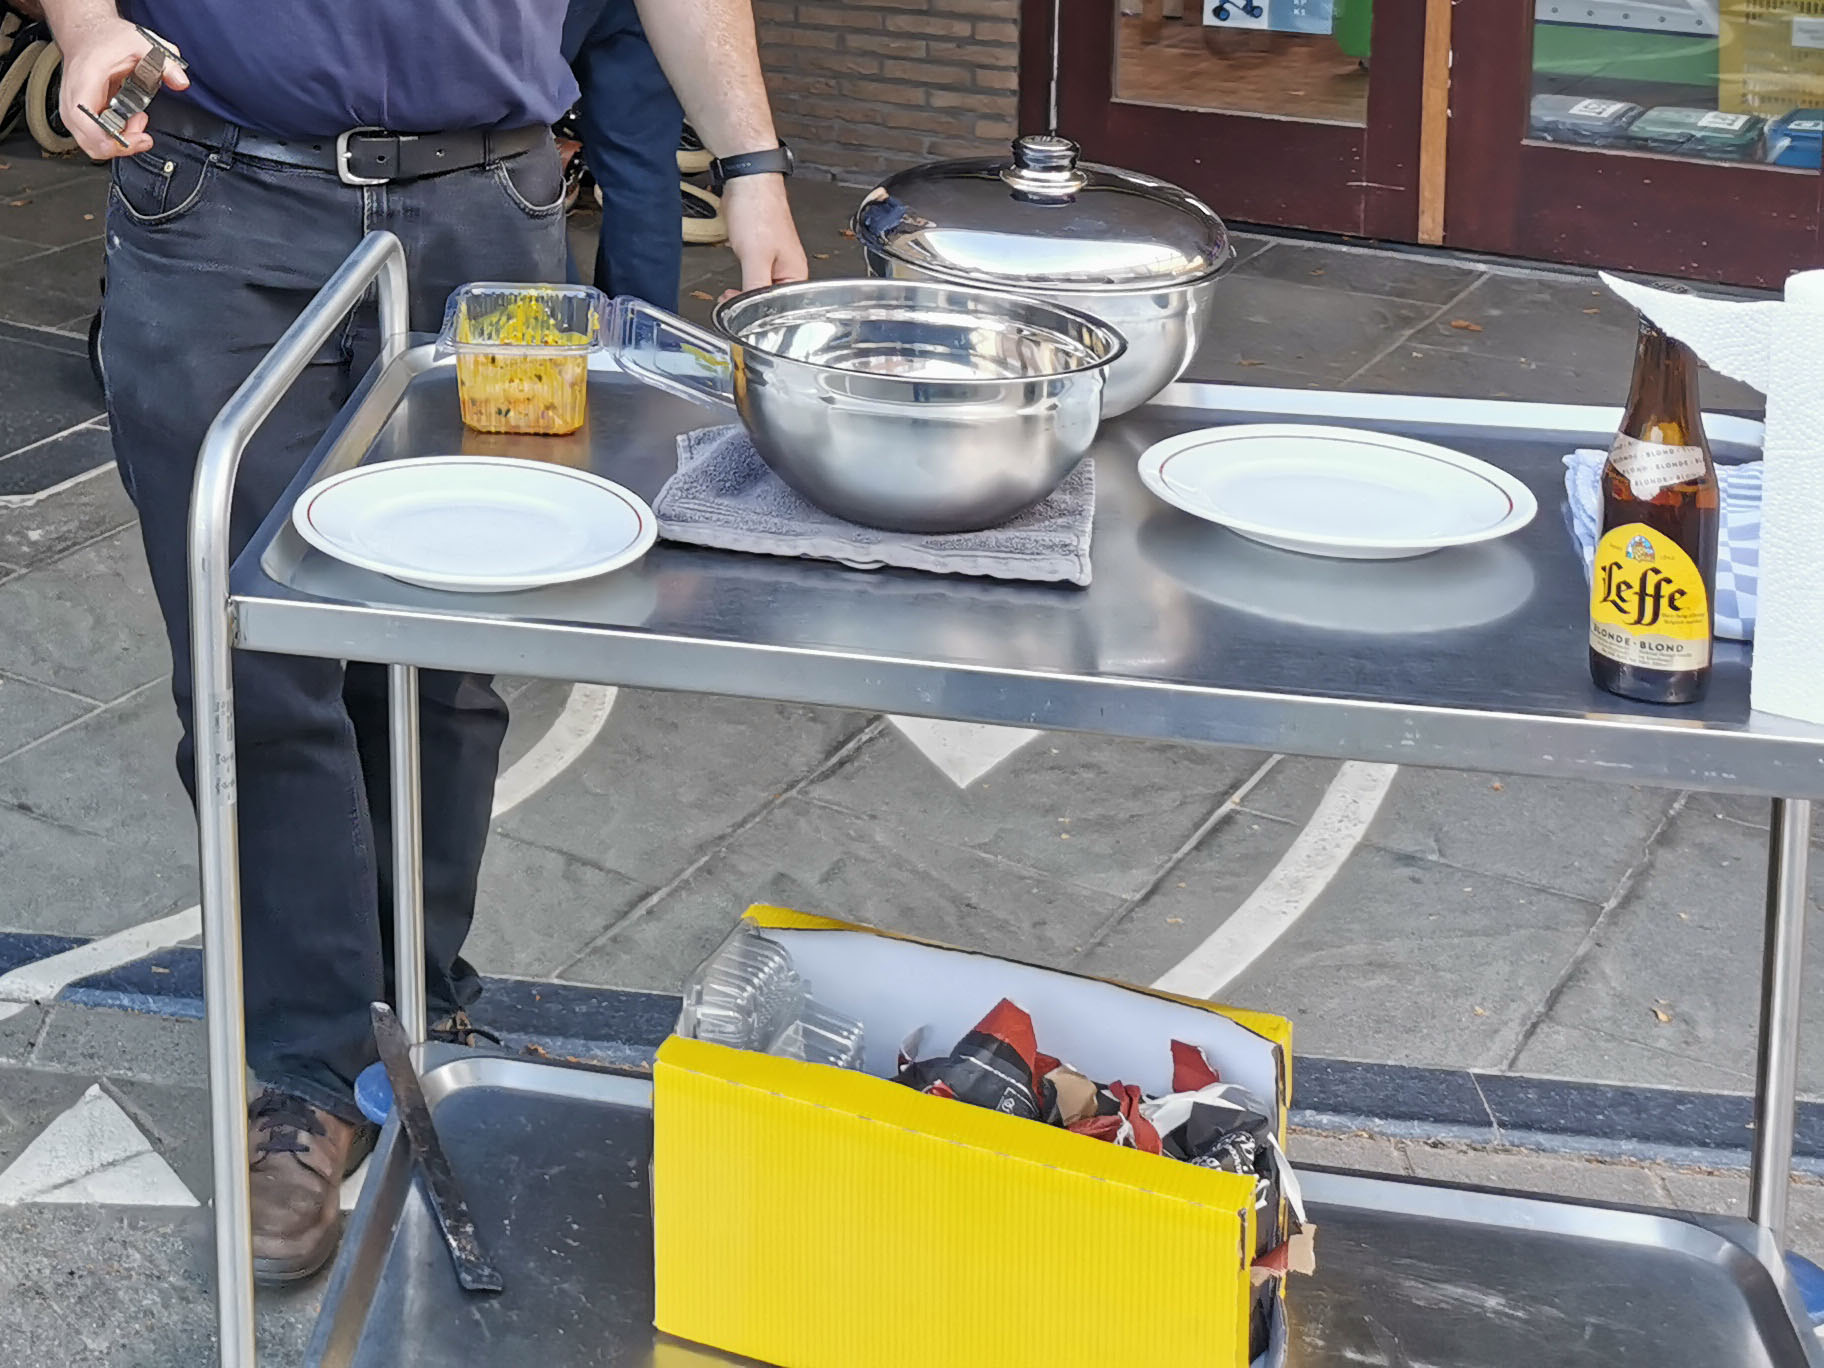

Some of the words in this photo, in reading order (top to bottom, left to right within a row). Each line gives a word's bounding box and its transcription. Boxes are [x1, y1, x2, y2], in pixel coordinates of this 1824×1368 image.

[1599, 561, 1688, 627] Leffe
[1593, 623, 1630, 646] BLONDE
[1639, 640, 1685, 653] BLOND
